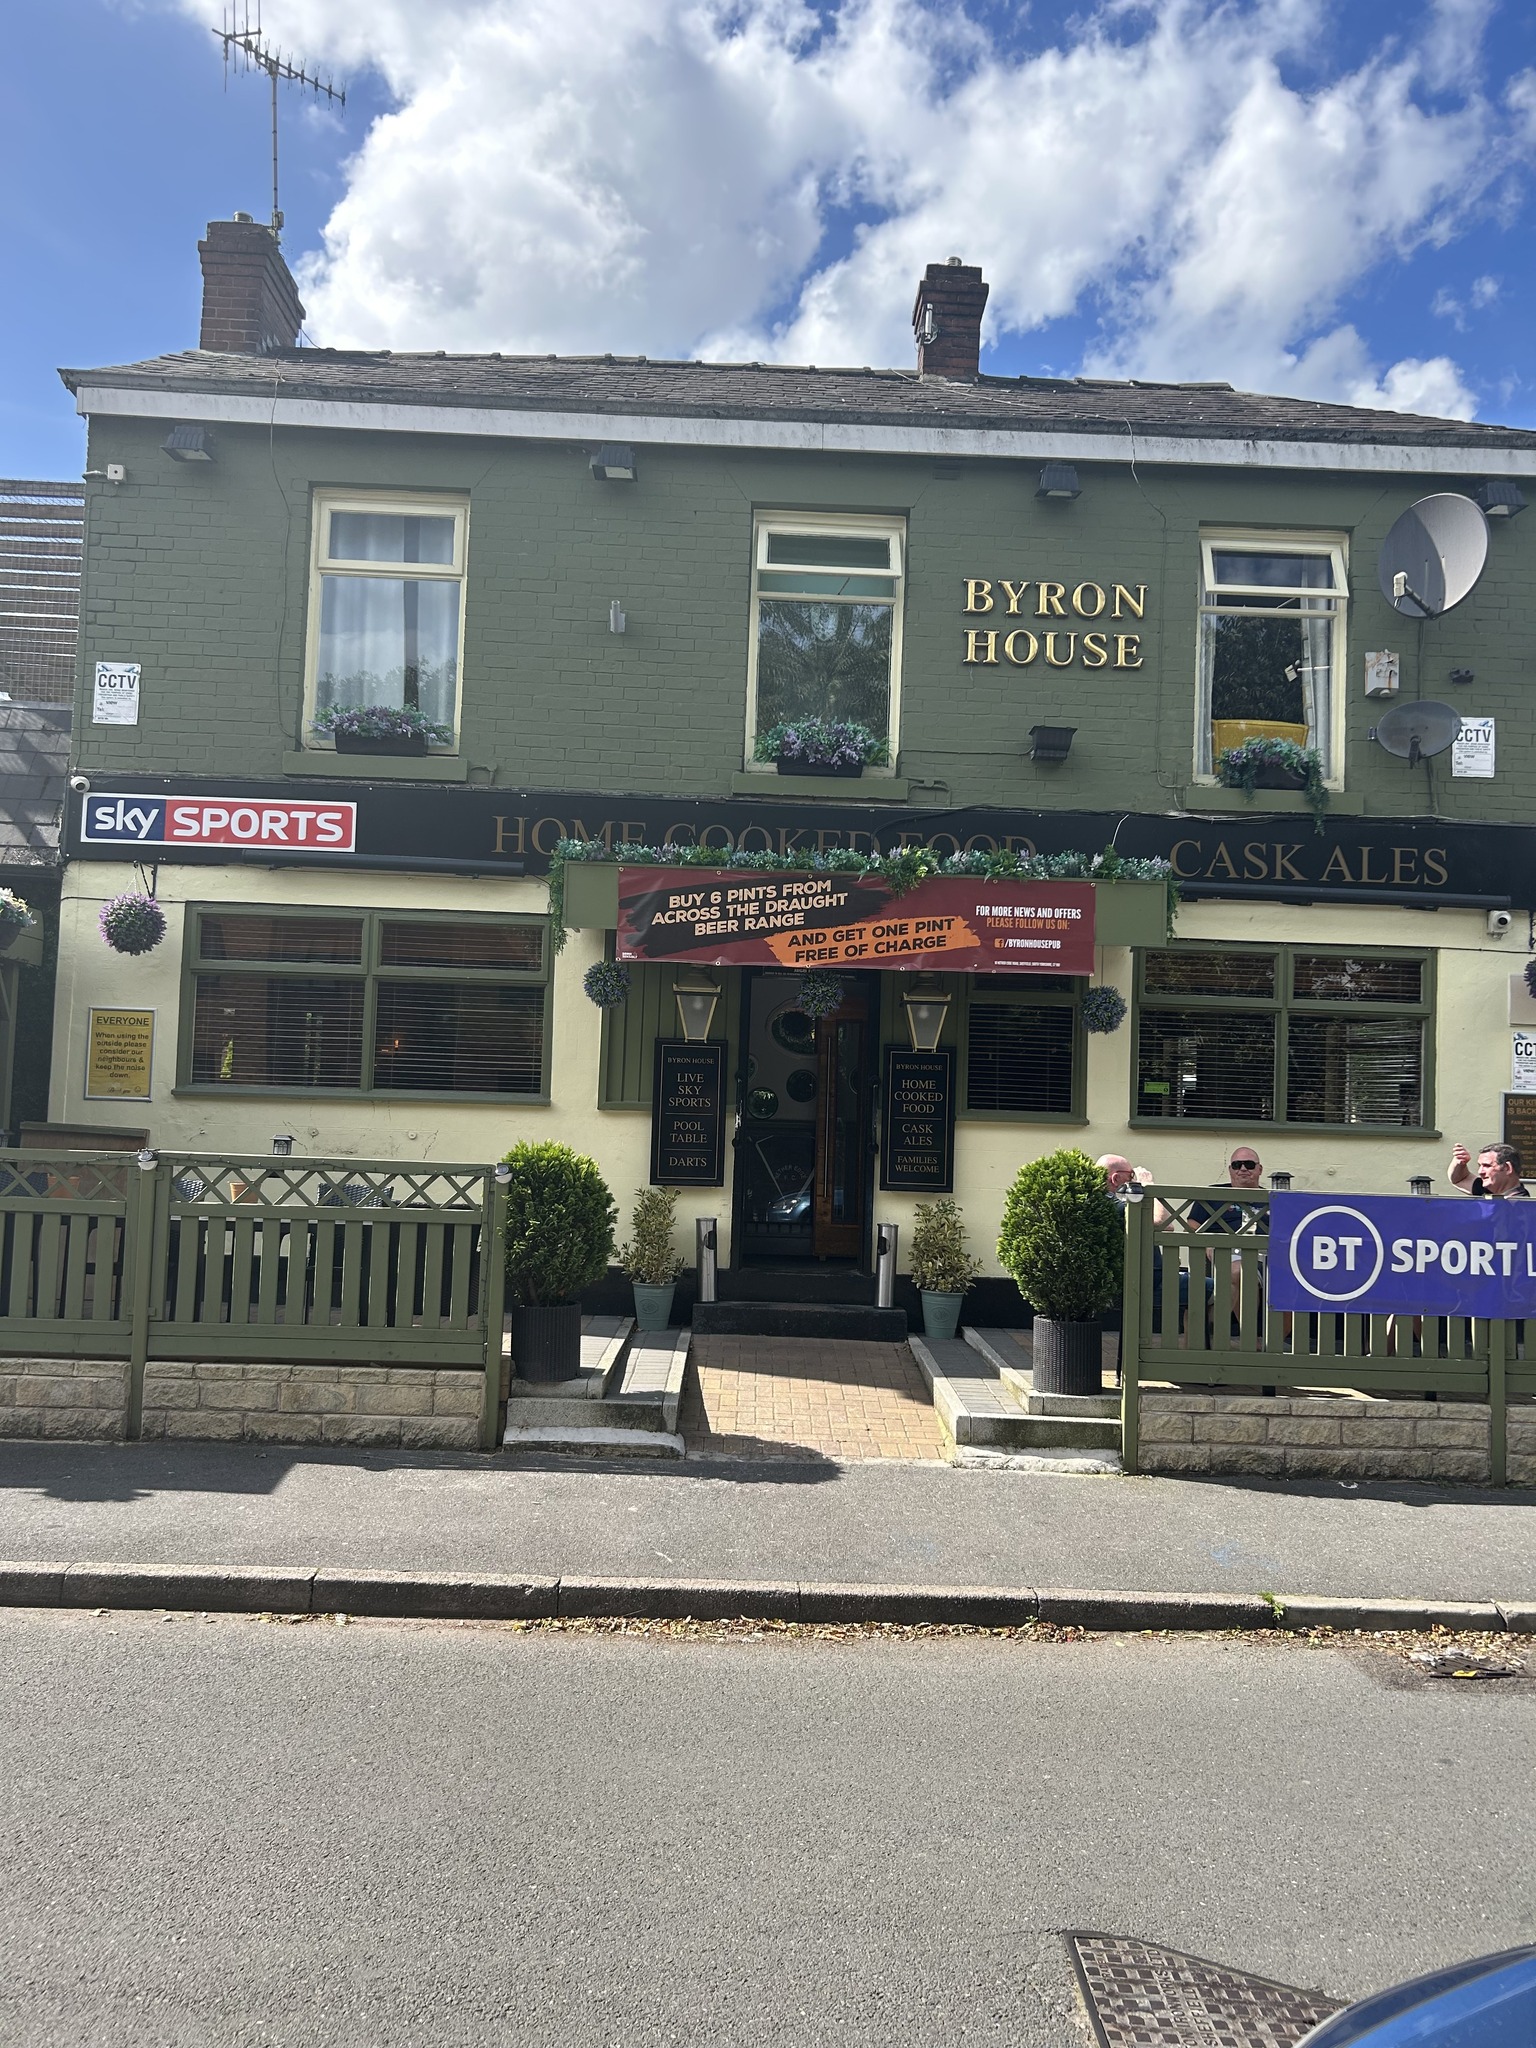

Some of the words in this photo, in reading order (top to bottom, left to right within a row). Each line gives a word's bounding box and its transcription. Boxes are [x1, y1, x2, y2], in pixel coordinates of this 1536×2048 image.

[962, 578, 1149, 619] BYRON
[962, 629, 1145, 668] HOUSE
[98, 673, 137, 689] CCTV
[95, 800, 159, 839] sky
[173, 806, 344, 842] SPORTS
[1169, 839, 1309, 881] CASK
[1318, 845, 1449, 886] ALES
[669, 891, 706, 909] BUY
[710, 891, 722, 904] 6
[727, 885, 777, 903] PINTS
[782, 879, 832, 897] FROM
[651, 906, 721, 926] ACROSS
[726, 901, 760, 918] THE
[765, 892, 849, 914] DRAUGHT
[975, 905, 990, 917] FOR
[991, 905, 1013, 917] MORE
[1013, 906, 1036, 918] NEWS
[1036, 907, 1053, 919] AND
[1054, 908, 1082, 920] OFFERS
[694, 919, 739, 936] BEER
[744, 912, 805, 931] RANGE
[986, 917, 1014, 929] PLEASE
[1015, 918, 1045, 929] FOLLOW
[1045, 919, 1056, 930] US
[1057, 919, 1070, 930] ON:
[787, 933, 827, 948] AND
[832, 928, 867, 944] GET
[871, 923, 909, 939] ONE
[915, 918, 956, 934] PINT
[795, 947, 841, 963] FREE
[844, 943, 870, 958] OF
[874, 935, 947, 955] CHARGE
[1004, 938, 1061, 949] /BYRONHOUSEPUB
[96, 1016, 150, 1026] EVERYONE
[116, 1032, 137, 1040] using
[97, 1056, 137, 1064] neighbours
[667, 1056, 691, 1064] BYRON
[692, 1057, 715, 1065] HOUSE
[677, 1072, 704, 1083] LIVE
[901, 1079, 937, 1089] HOME
[678, 1085, 702, 1095] SKY
[894, 1091, 943, 1102] COOKED
[668, 1097, 711, 1108] SPORTS
[902, 1103, 935, 1114] FOOD
[673, 1120, 704, 1131] POOL
[902, 1123, 933, 1134] CASK
[670, 1133, 708, 1144] TABLE
[903, 1136, 933, 1146] ALES
[669, 1156, 707, 1167] DARTS
[897, 1155, 938, 1164] FAMILIES
[895, 1165, 940, 1173] WELCOME
[1312, 1235, 1363, 1271] BT
[1391, 1238, 1518, 1277] SPORT
[1181, 1986, 1219, 2047] SHEFFIELD
